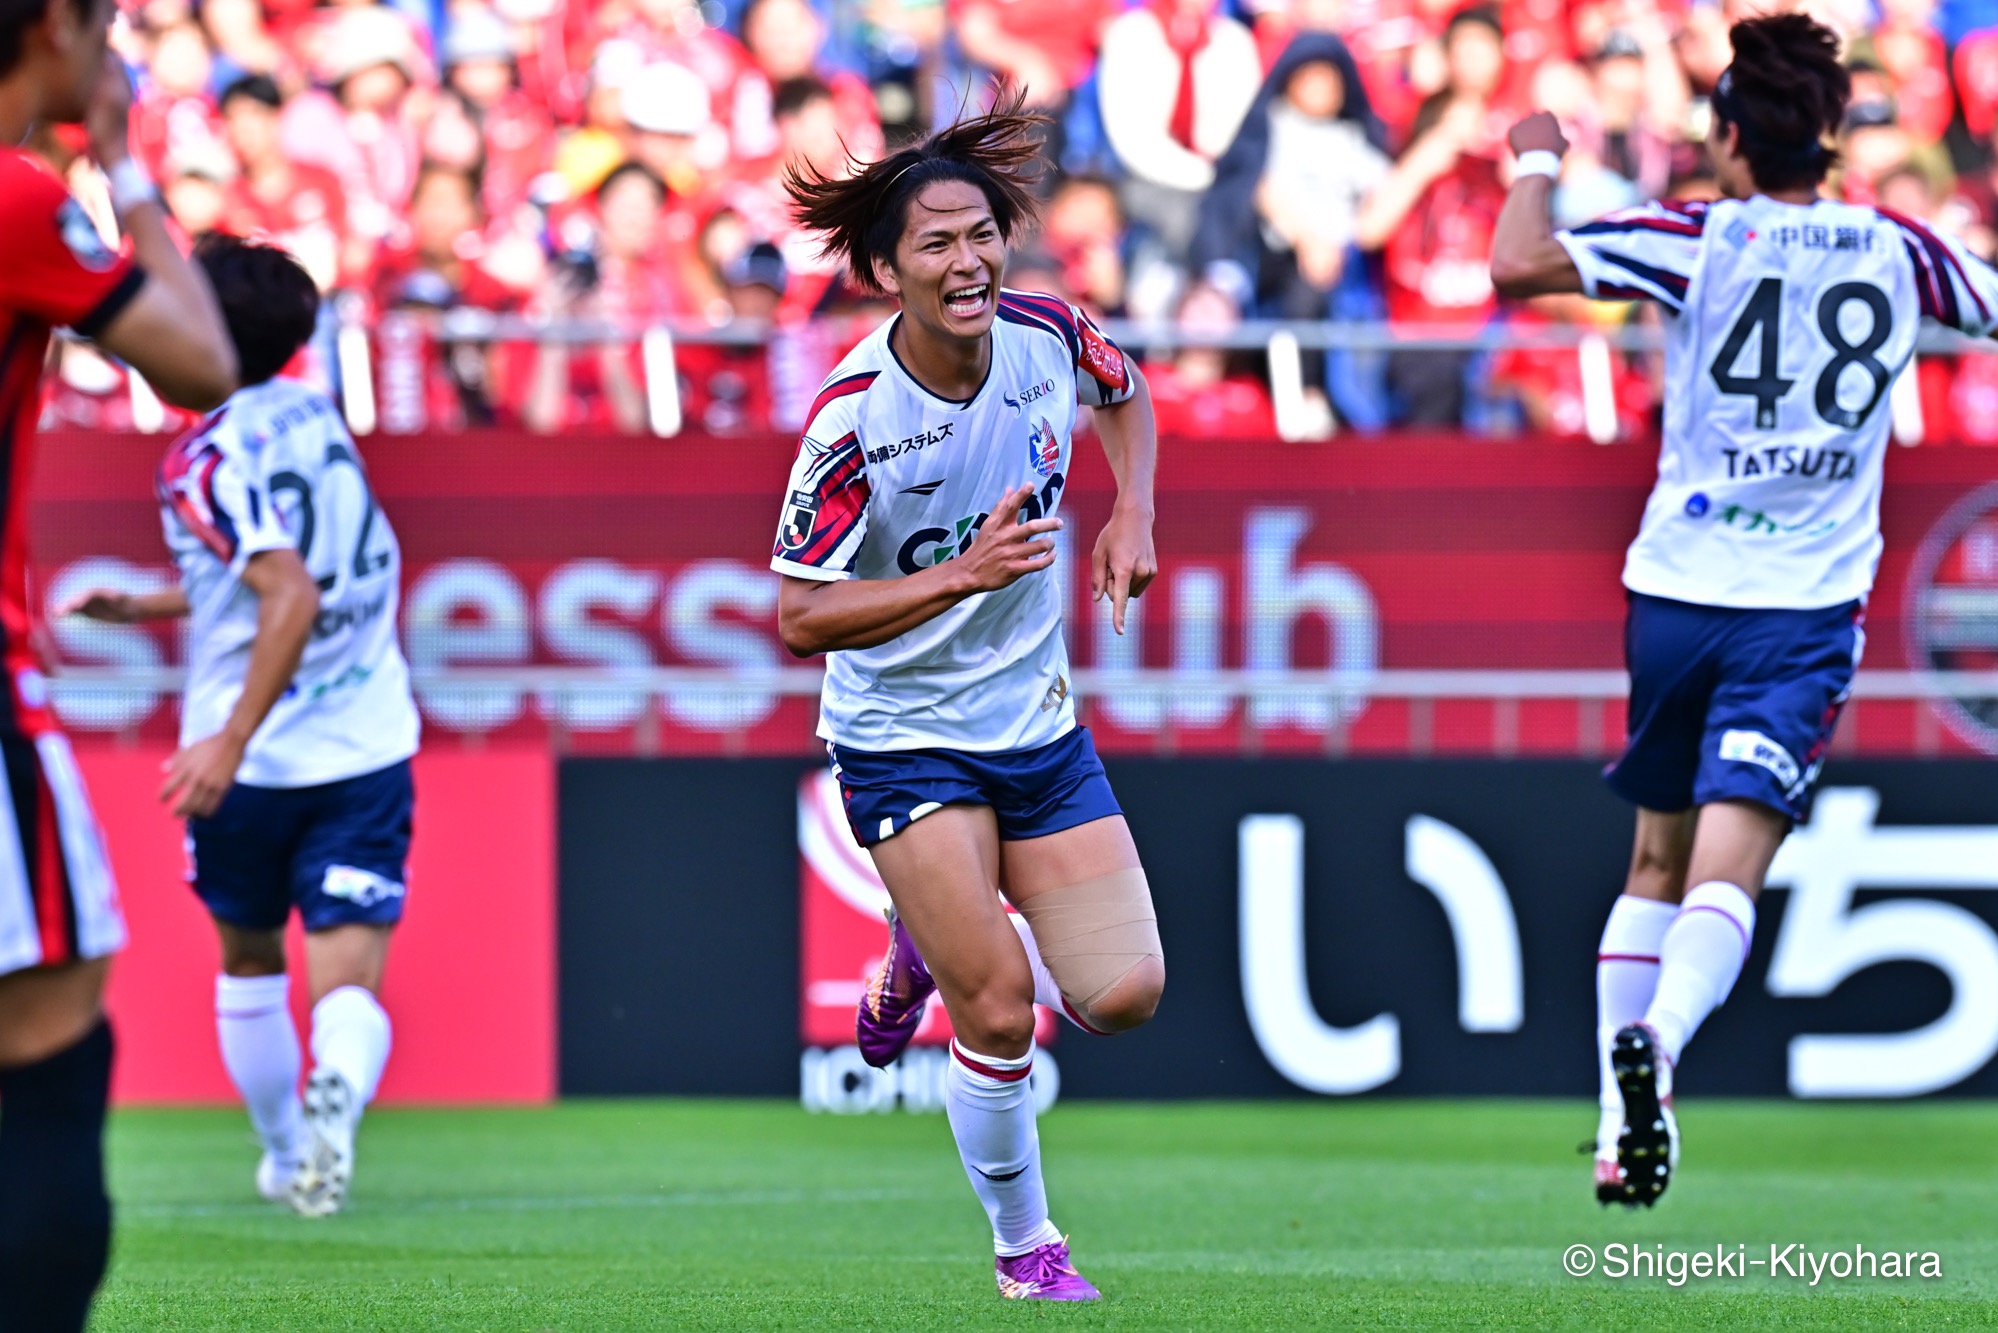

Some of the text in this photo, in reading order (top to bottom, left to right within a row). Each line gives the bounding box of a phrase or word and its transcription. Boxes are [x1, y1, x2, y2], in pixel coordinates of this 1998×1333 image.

[1710, 277, 1893, 431] 48
[1020, 378, 1056, 406] SERIO
[1722, 446, 1856, 480] TATSUTA
